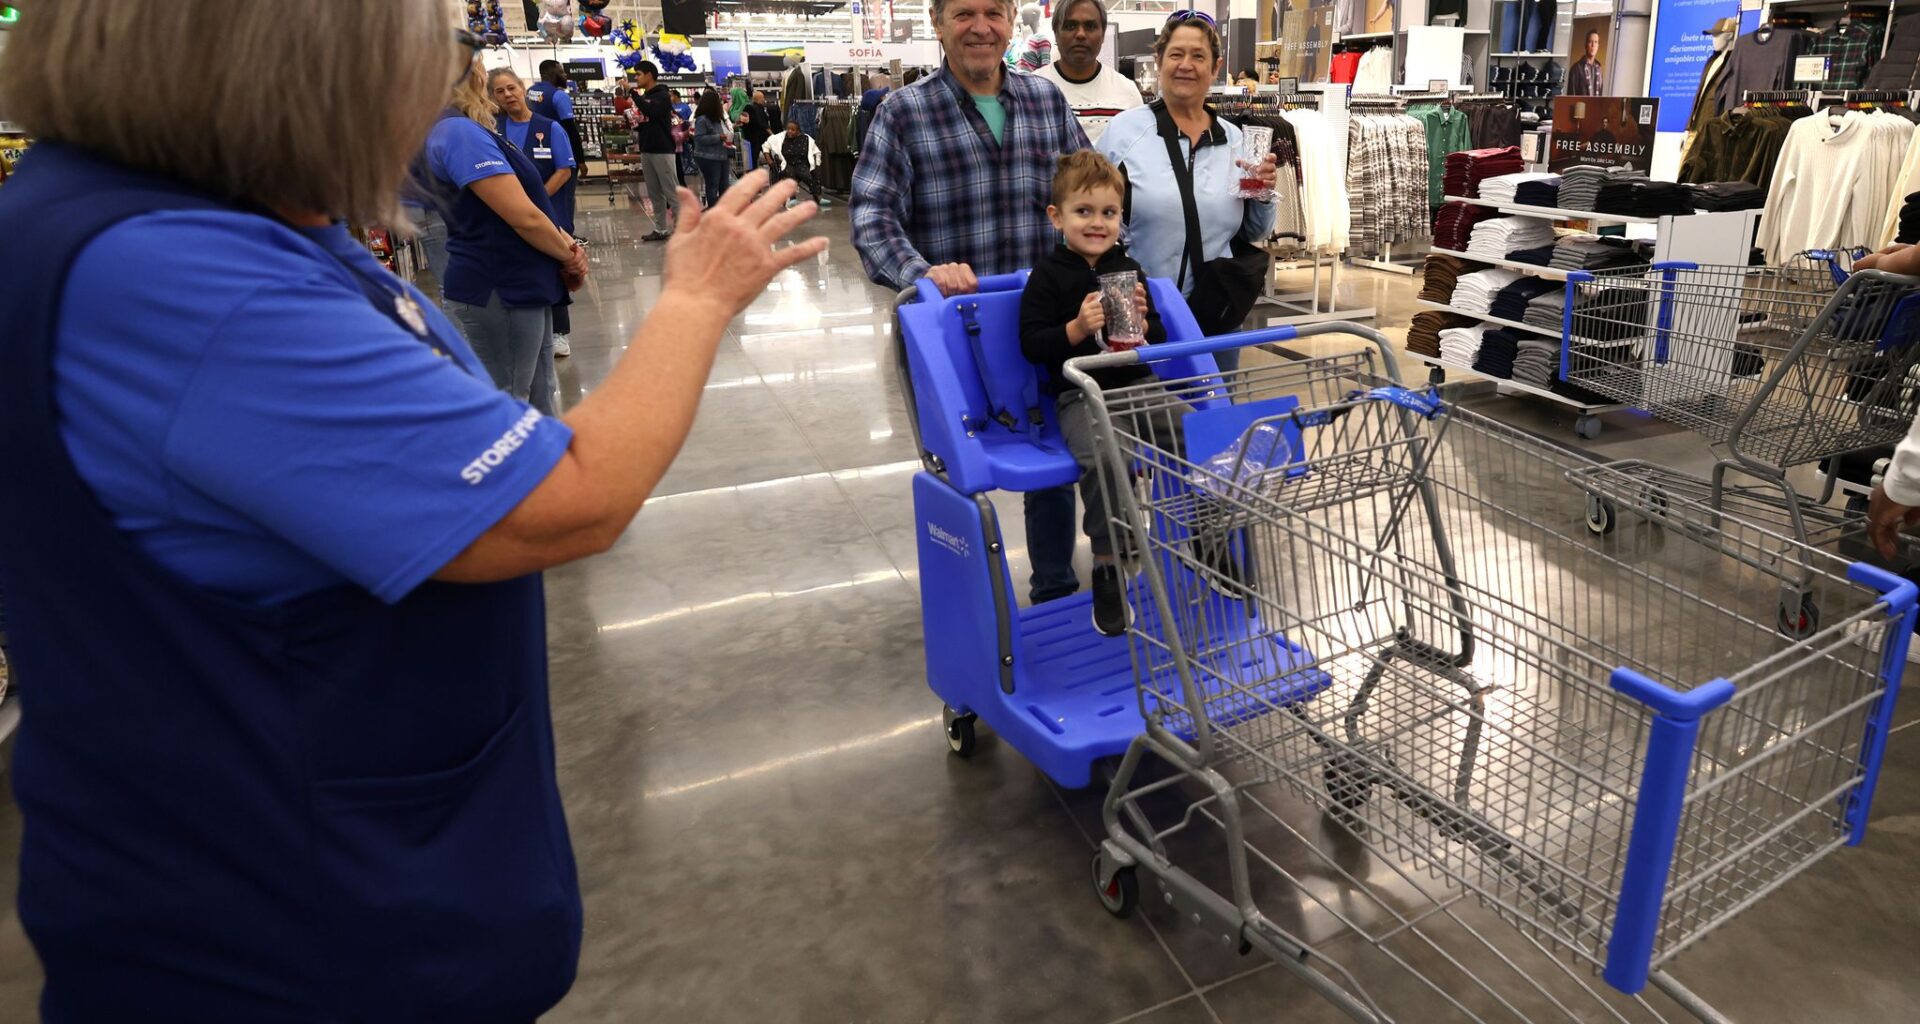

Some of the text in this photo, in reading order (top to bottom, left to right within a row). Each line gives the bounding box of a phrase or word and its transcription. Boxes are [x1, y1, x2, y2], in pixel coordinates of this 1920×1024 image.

[1681, 31, 1699, 41] Únete
[1300, 41, 1328, 49] ASSEMBLY
[1670, 44, 1706, 53] diariamente
[849, 46, 883, 57] SOFÍA
[1665, 53, 1695, 64] amigables
[1556, 140, 1645, 156] FREE ASSEMBLY
[461, 429, 525, 485] STORE
[927, 520, 961, 550] Walmart
